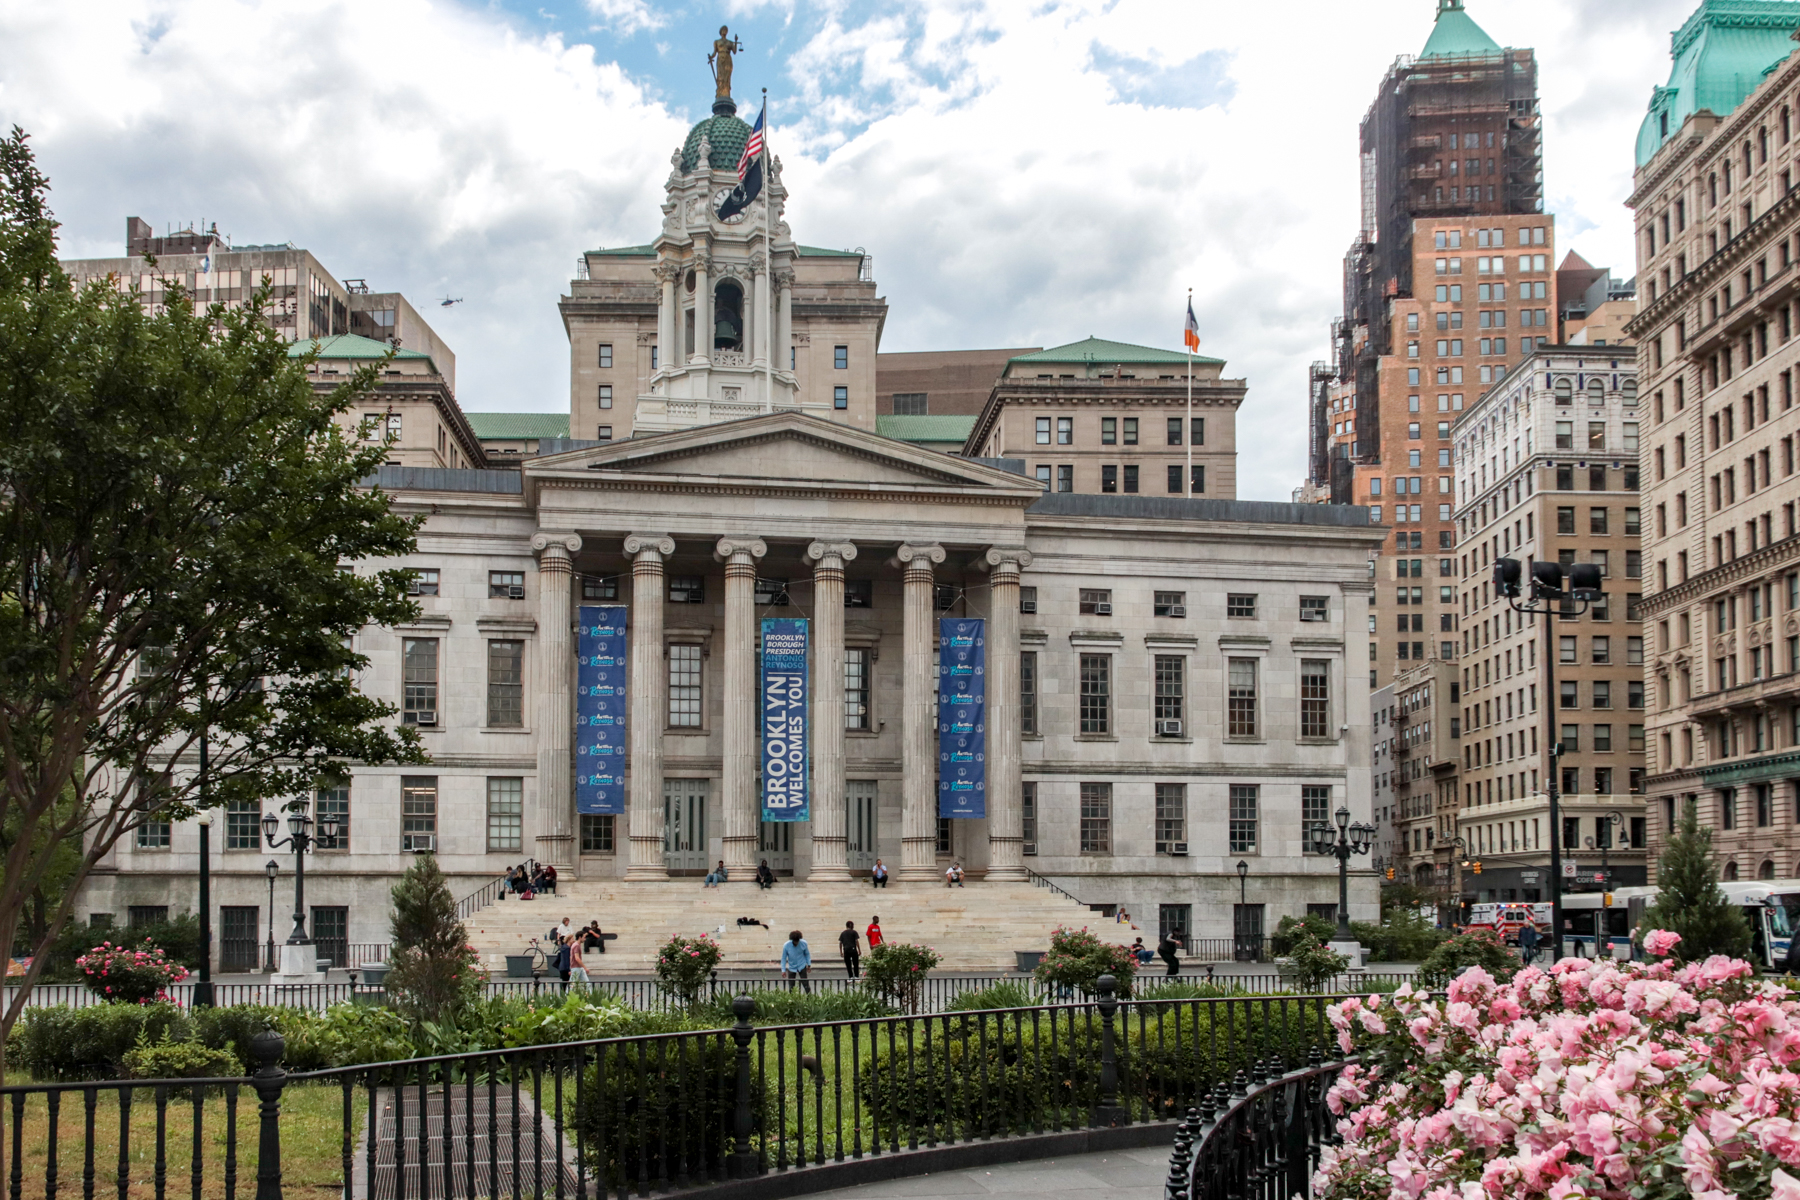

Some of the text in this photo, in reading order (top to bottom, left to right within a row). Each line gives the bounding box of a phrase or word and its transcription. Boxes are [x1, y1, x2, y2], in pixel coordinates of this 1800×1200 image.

[766, 676, 787, 808] BROOKLYN
[789, 677, 803, 808] WELCOMES YOU
